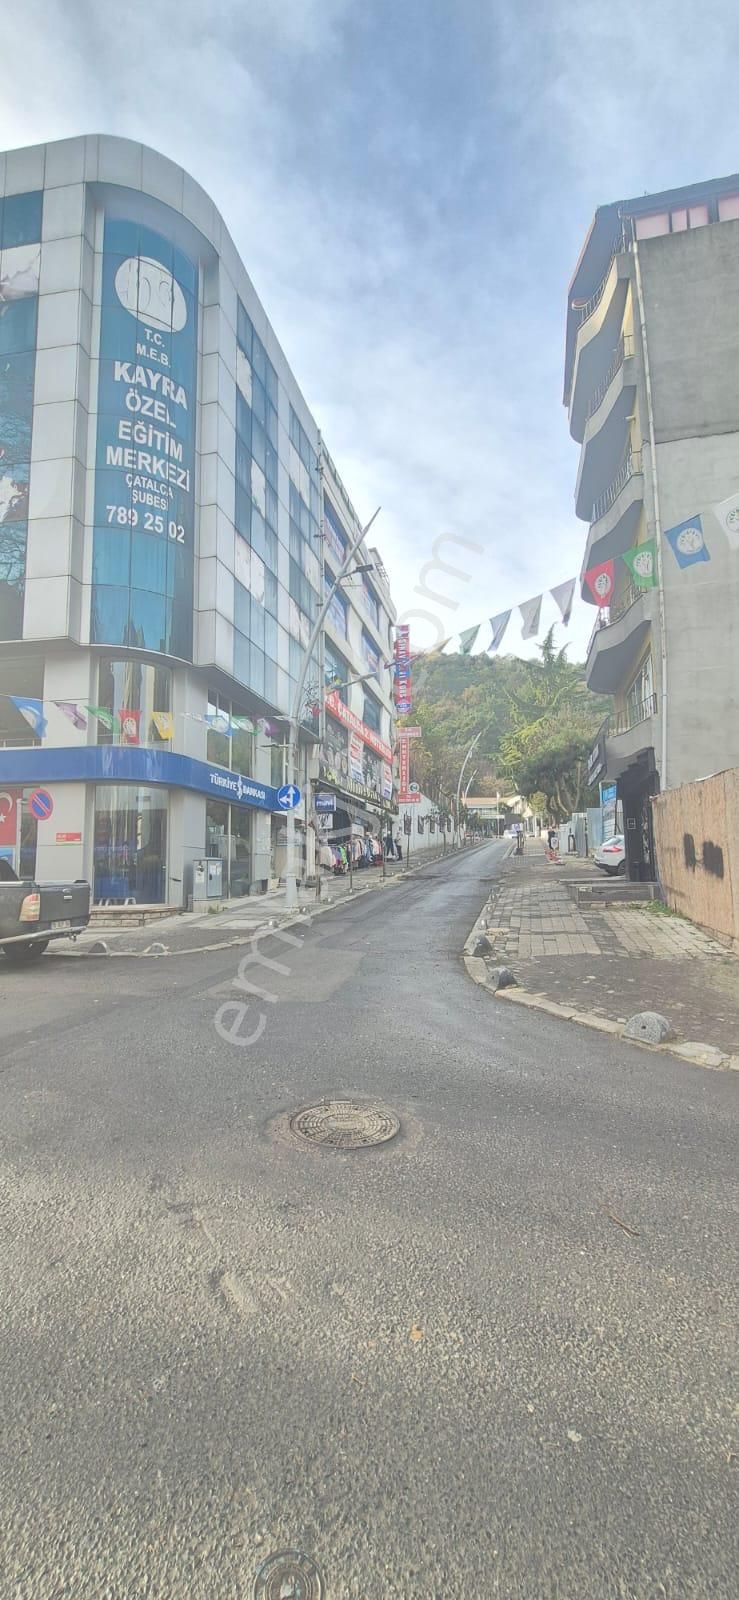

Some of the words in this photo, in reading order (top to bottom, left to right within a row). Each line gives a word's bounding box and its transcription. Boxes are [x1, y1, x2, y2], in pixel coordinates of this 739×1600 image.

[136, 343, 171, 368] M.E.B.
[144, 328, 165, 348] T.C.
[114, 360, 188, 410] KAYRA
[125, 387, 176, 428] ÖZEL
[118, 419, 183, 462] EĞİTİM
[106, 445, 190, 492] MERKEZİ
[106, 505, 138, 526] 789
[144, 512, 164, 533] 25
[168, 521, 185, 544] 02
[209, 772, 238, 791] TÜRKİYE
[242, 784, 266, 800] BANKASI
